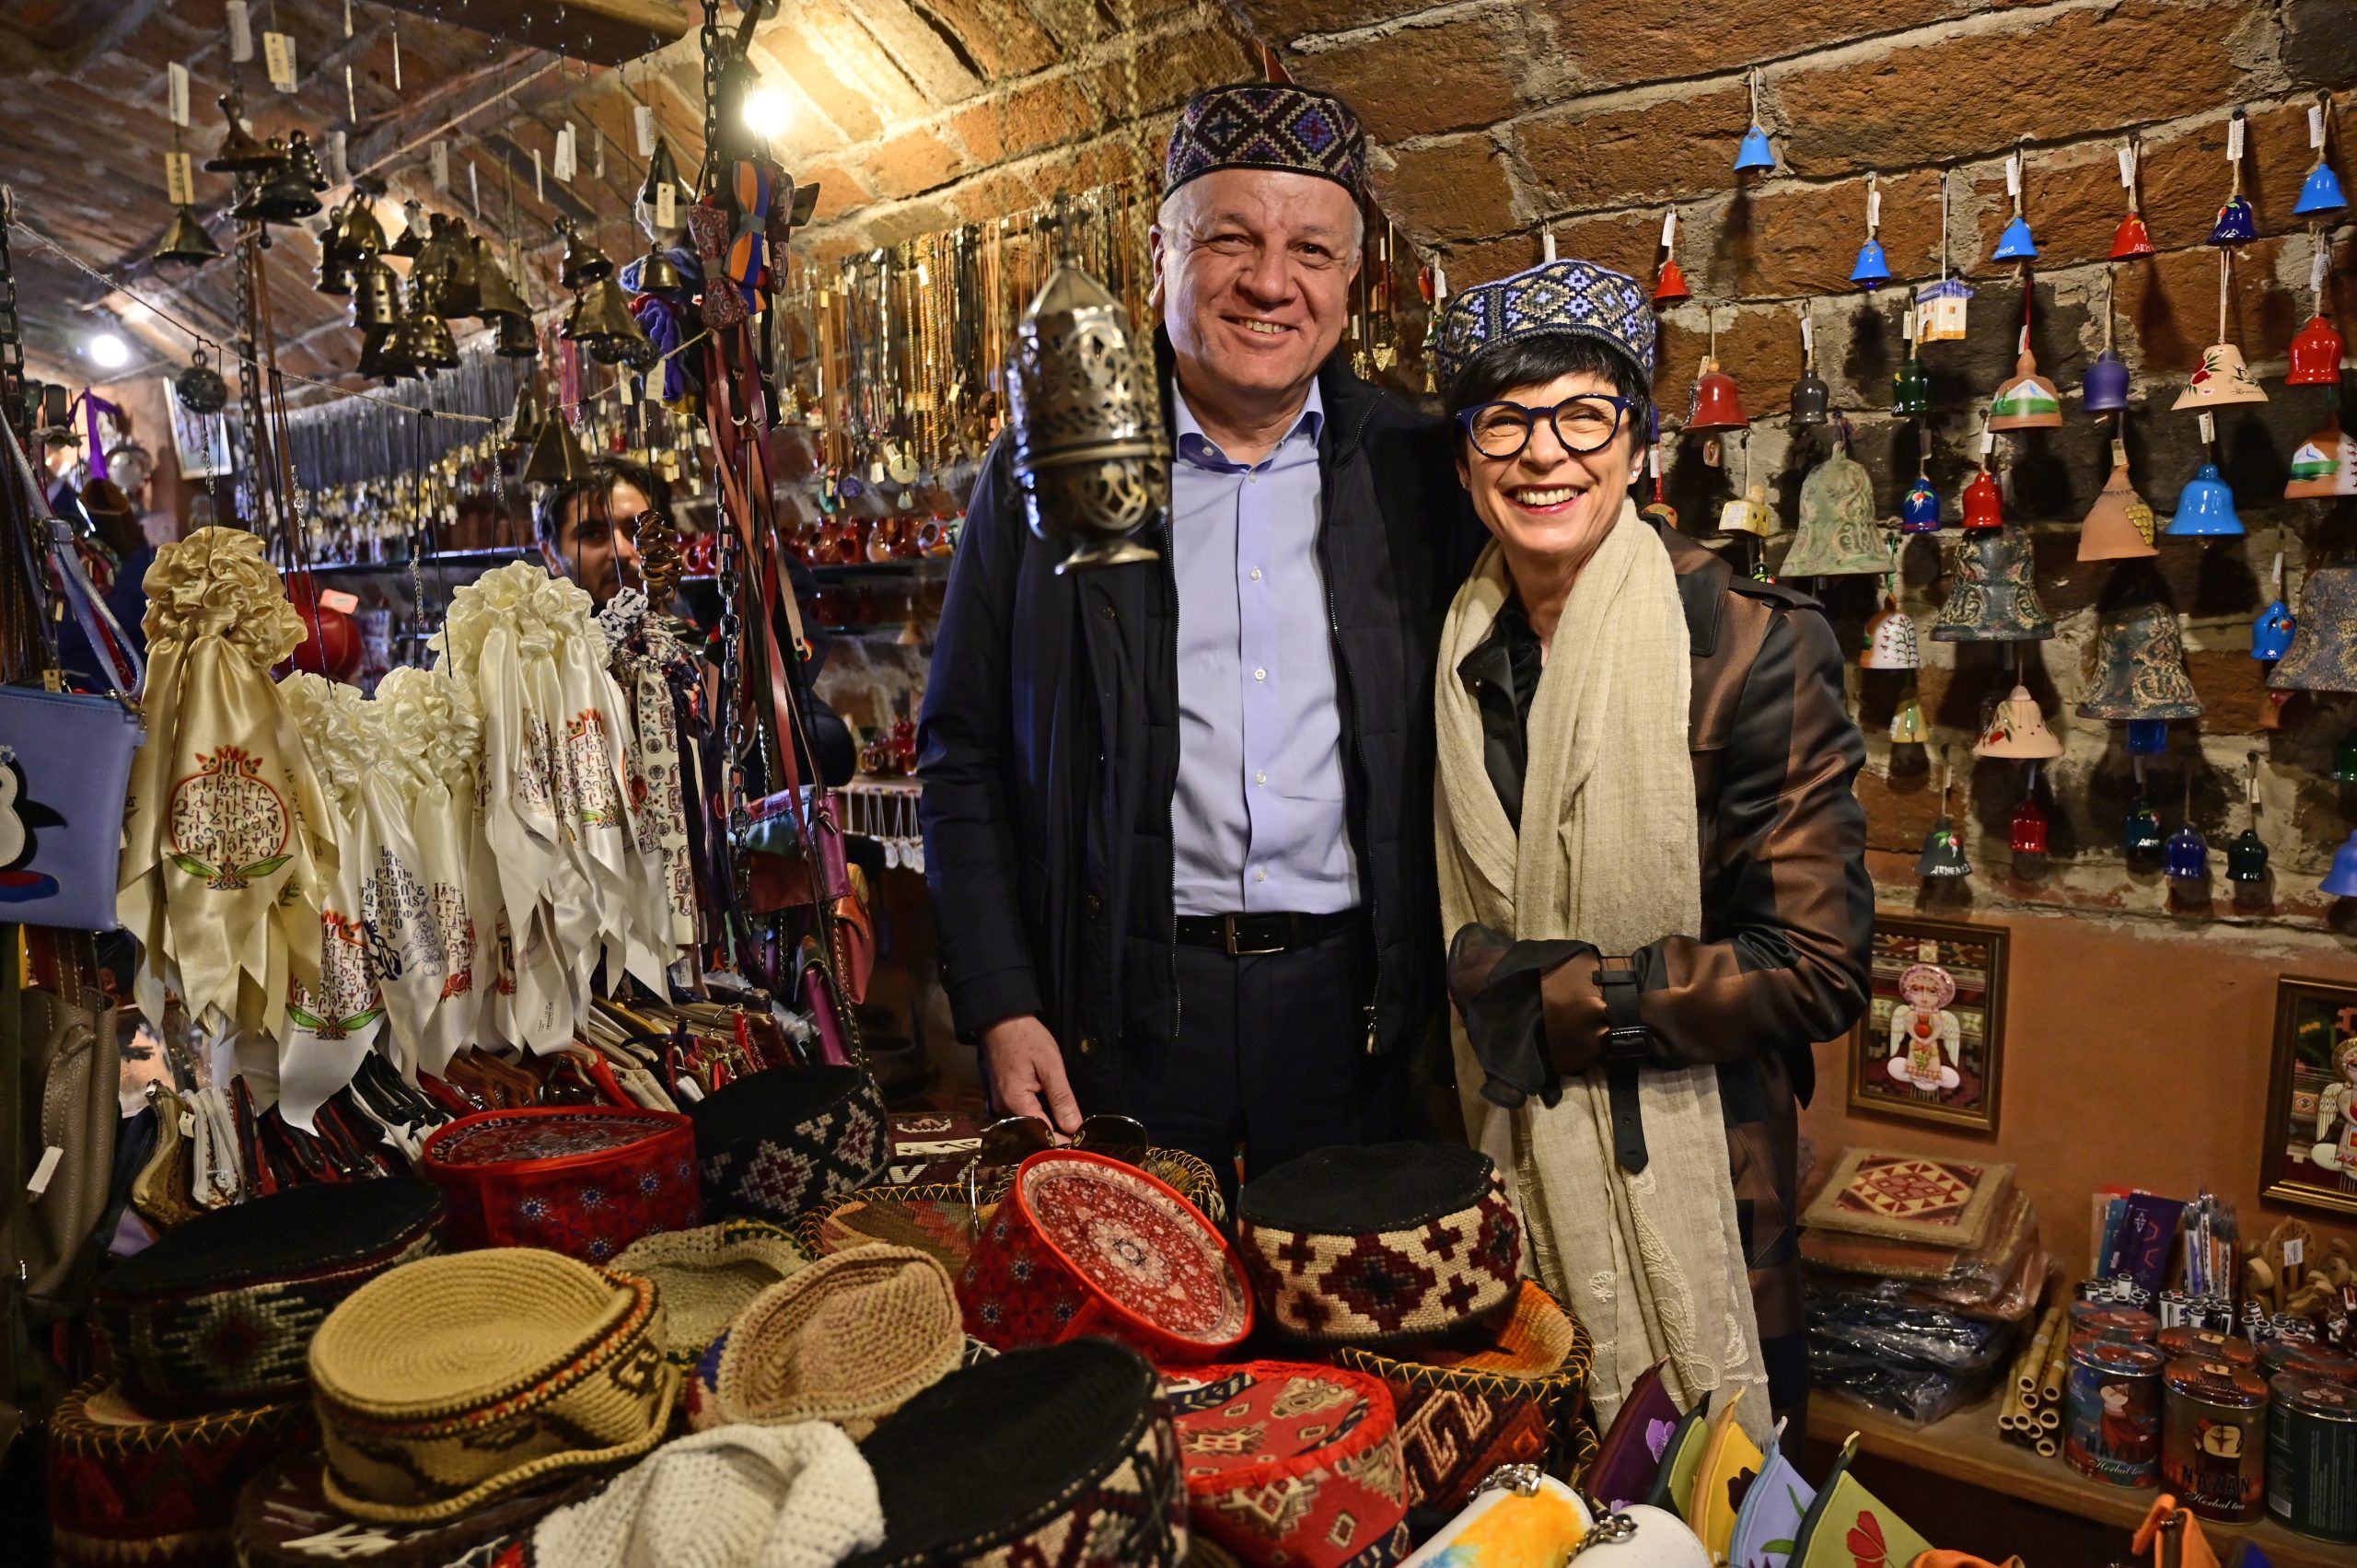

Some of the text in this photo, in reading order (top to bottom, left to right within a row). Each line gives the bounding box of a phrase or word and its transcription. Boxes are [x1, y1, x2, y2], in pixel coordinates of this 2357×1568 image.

[2183, 1464, 2251, 1494] NAZAN
[2184, 1492, 2246, 1511] Herbal tea
